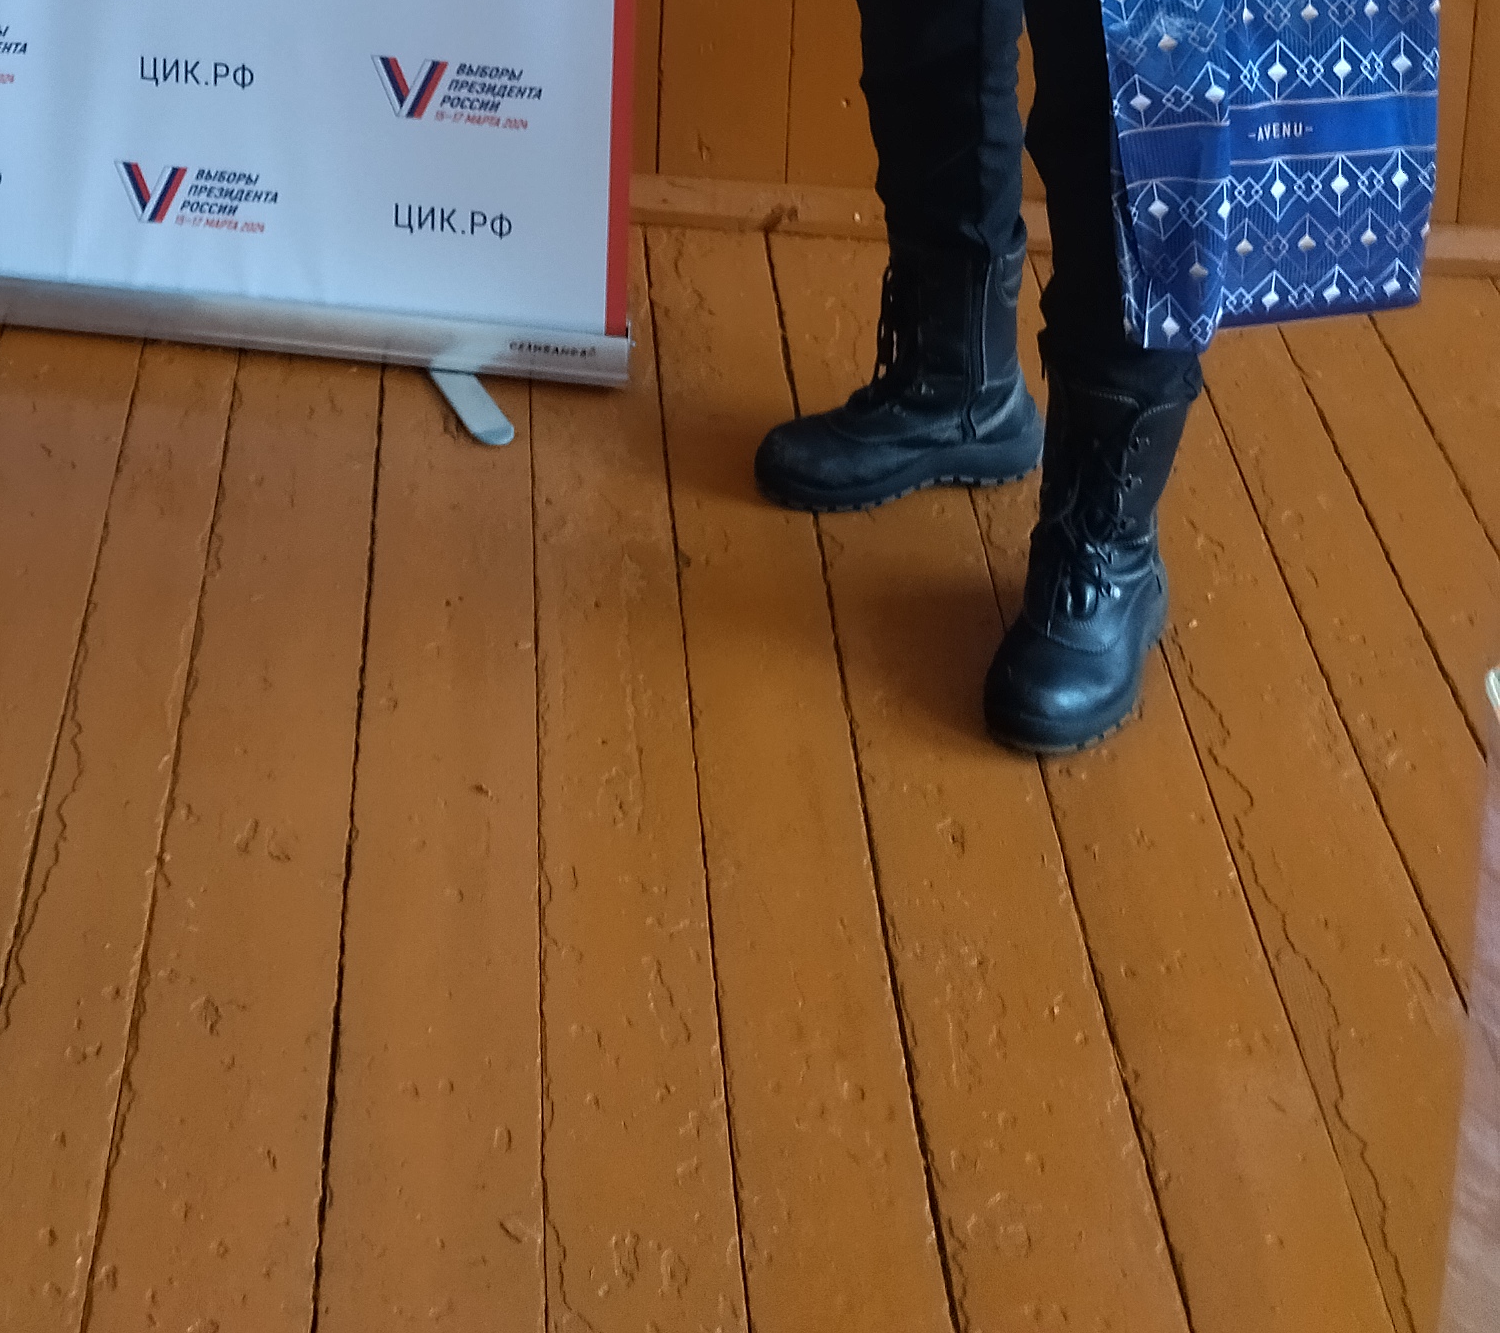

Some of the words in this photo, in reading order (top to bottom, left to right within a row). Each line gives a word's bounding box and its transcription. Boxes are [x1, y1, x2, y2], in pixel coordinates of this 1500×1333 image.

[141, 56, 253, 90] ЦИК.РФ
[457, 64, 523, 81] ВЫБОРЫ
[448, 80, 542, 100] ПРЕЗИДЕНТА
[440, 95, 500, 112] РОССИИ
[196, 169, 259, 185] ВЫБОРЫ
[188, 185, 278, 203] ПРЕЗИДЕНТА
[181, 200, 238, 216] РОССИИ
[395, 203, 512, 239] ЦИК.РФ
